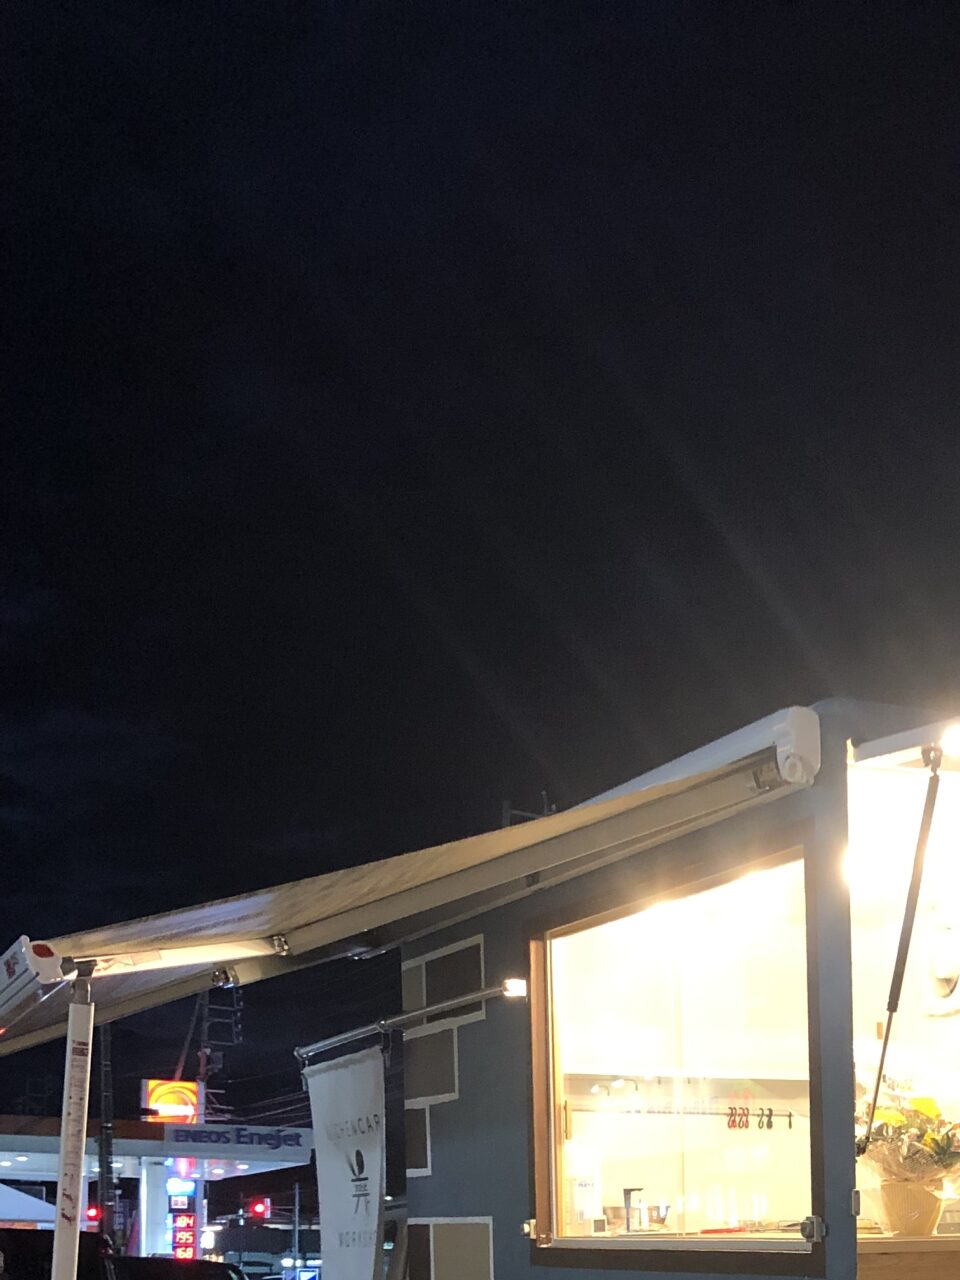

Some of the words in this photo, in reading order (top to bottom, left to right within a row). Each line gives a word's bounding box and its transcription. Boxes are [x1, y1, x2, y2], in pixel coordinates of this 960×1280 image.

[174, 1128, 231, 1144] ENEOS
[175, 1215, 195, 1229] 184
[175, 1231, 194, 1244] 195
